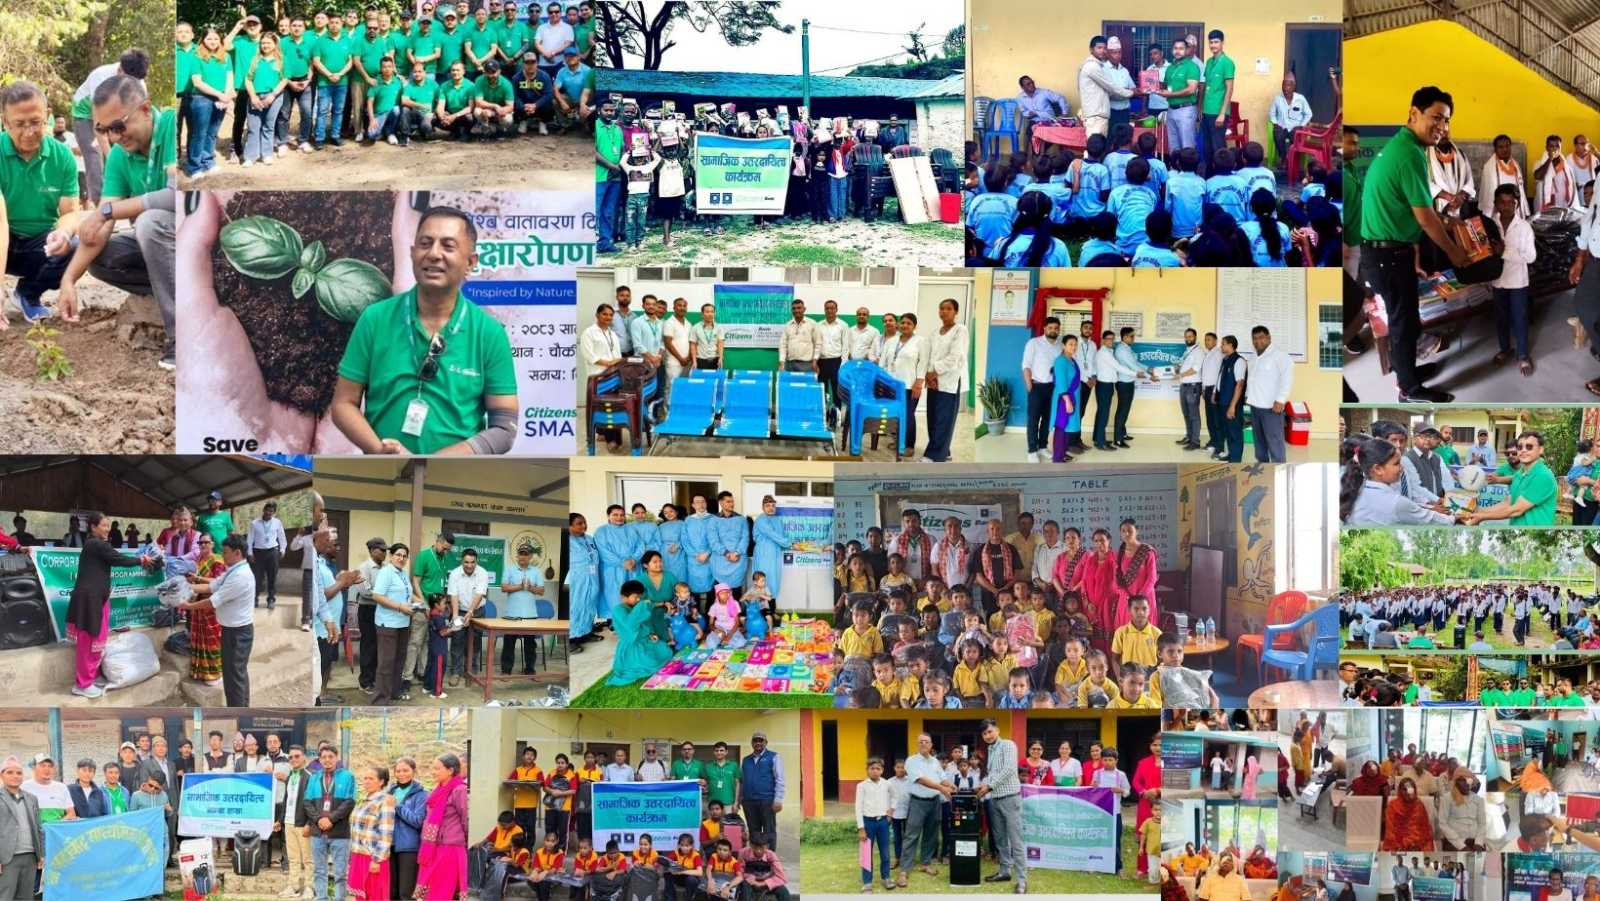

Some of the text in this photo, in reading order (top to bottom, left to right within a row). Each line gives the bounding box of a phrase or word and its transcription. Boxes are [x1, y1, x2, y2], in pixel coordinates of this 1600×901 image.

[505, 214, 575, 230] वातावरण
[472, 235, 595, 272] क्षारोपण
[520, 287, 533, 299] by
[524, 407, 577, 419] Citizens
[203, 436, 259, 453] Save
[1071, 479, 1109, 489] TABLE
